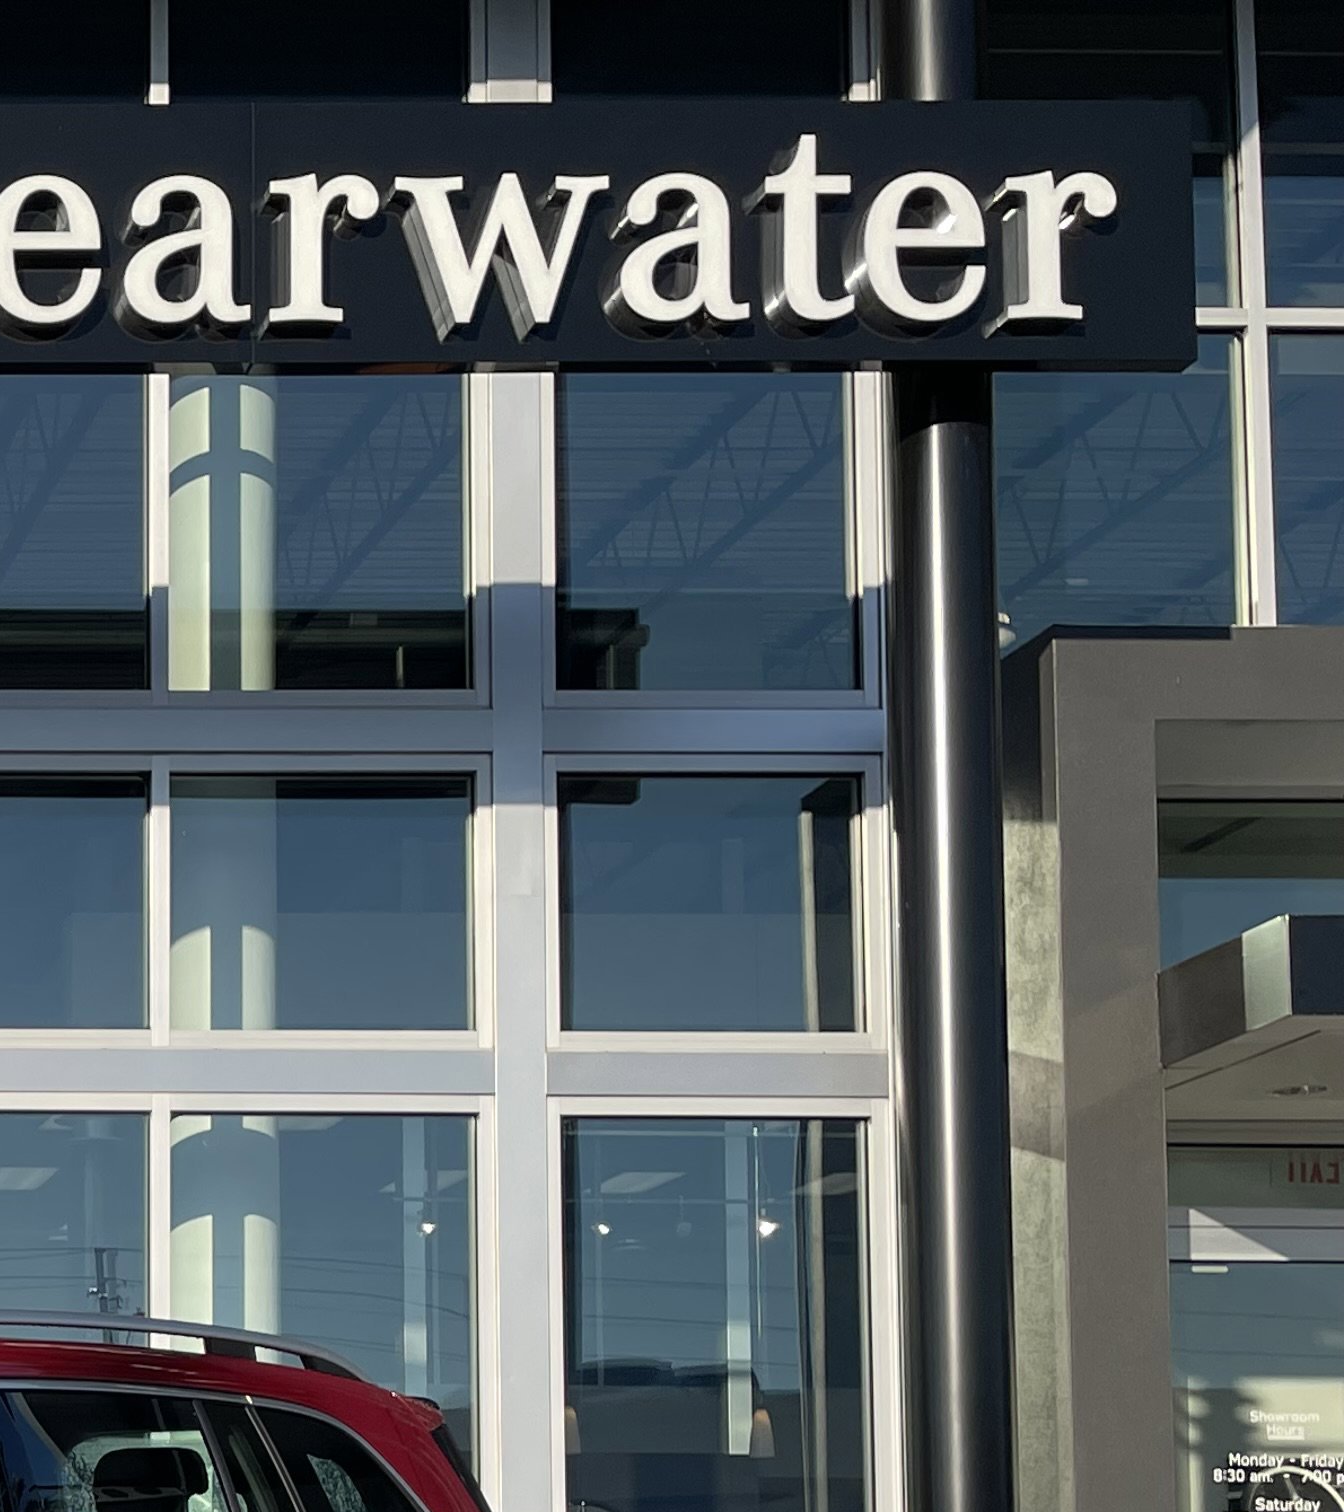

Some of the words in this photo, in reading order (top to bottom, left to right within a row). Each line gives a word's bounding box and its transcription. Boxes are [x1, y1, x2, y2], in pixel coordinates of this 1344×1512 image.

[1249, 1409, 1320, 1423] Showroom
[1266, 1423, 1305, 1437] Hours
[1228, 1452, 1284, 1469] Monday
[1300, 1453, 1344, 1471] Friday
[1213, 1467, 1246, 1483] 8:30
